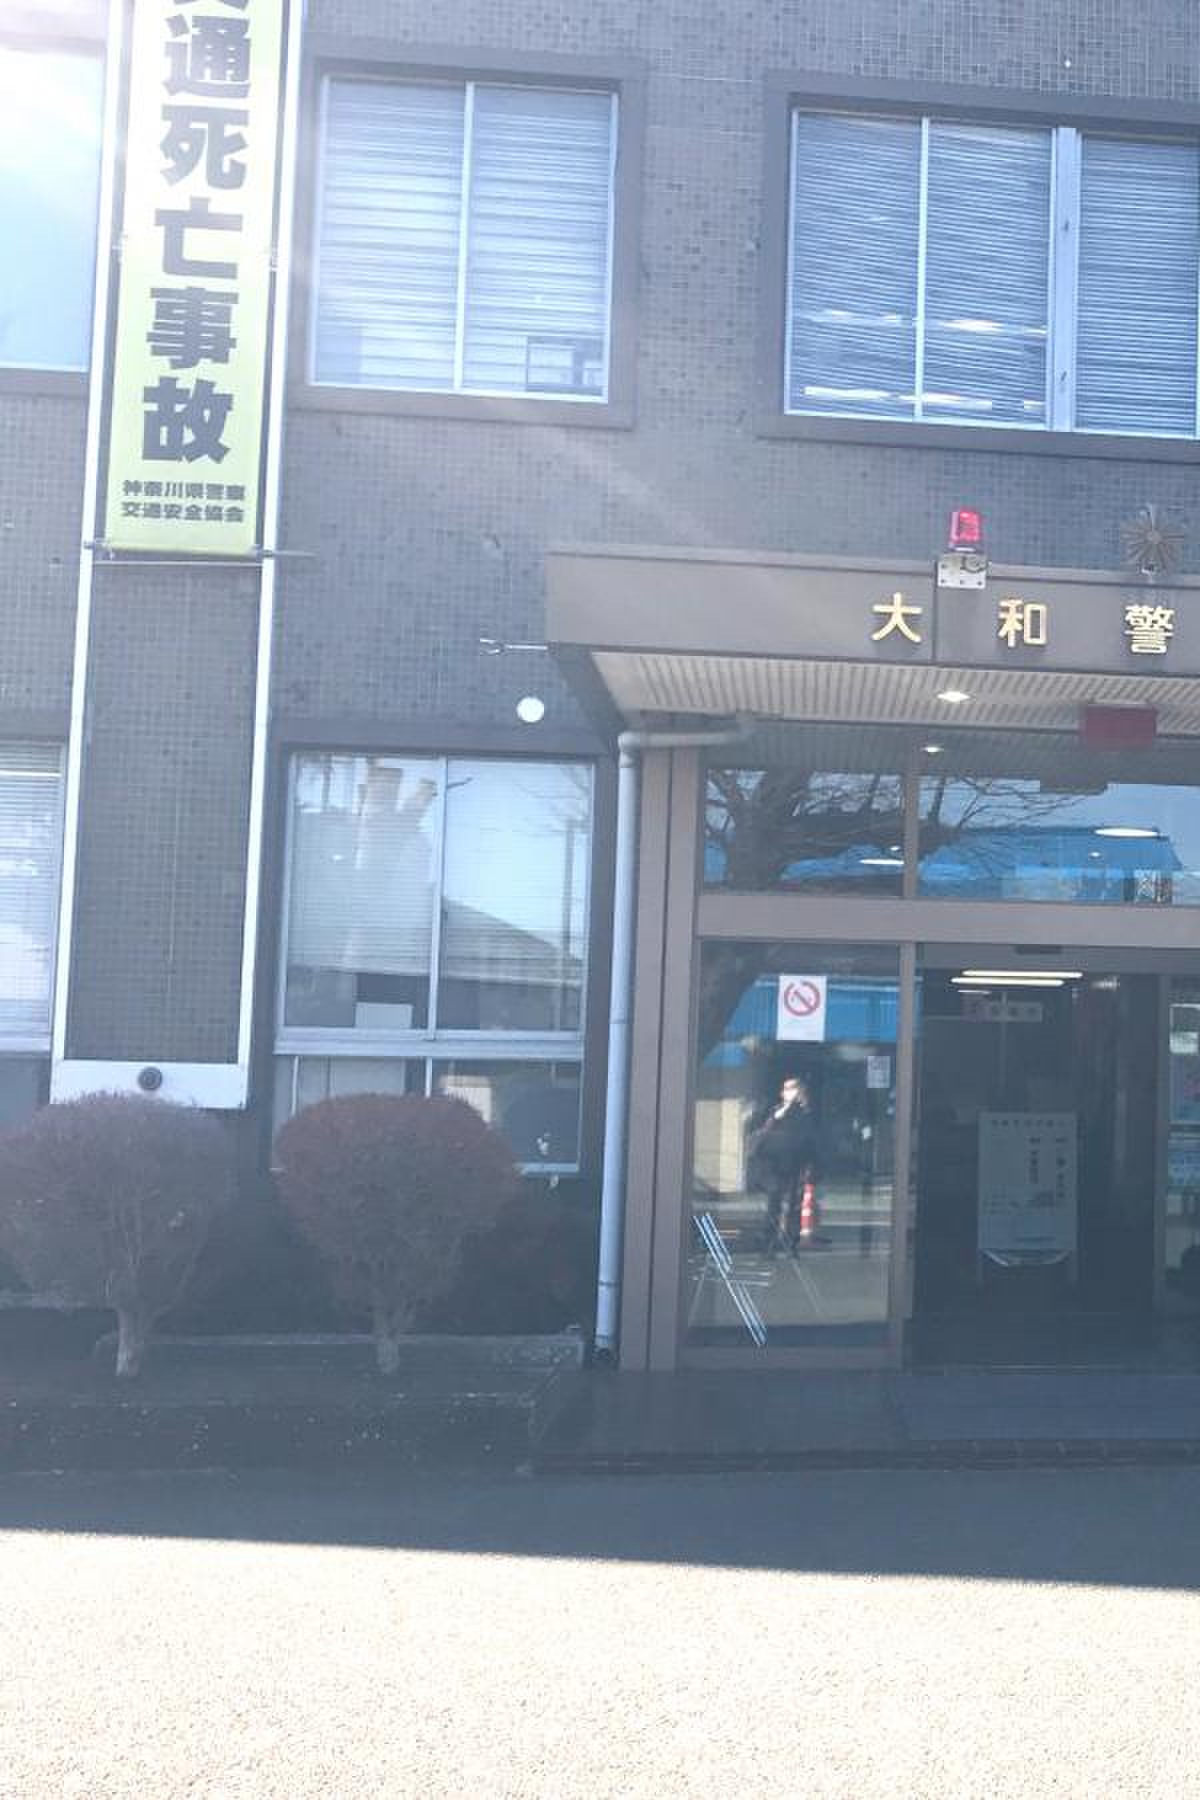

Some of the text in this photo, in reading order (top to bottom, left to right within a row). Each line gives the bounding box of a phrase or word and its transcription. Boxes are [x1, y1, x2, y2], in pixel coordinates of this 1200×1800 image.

[142, 0, 252, 464] 通死亡事故
